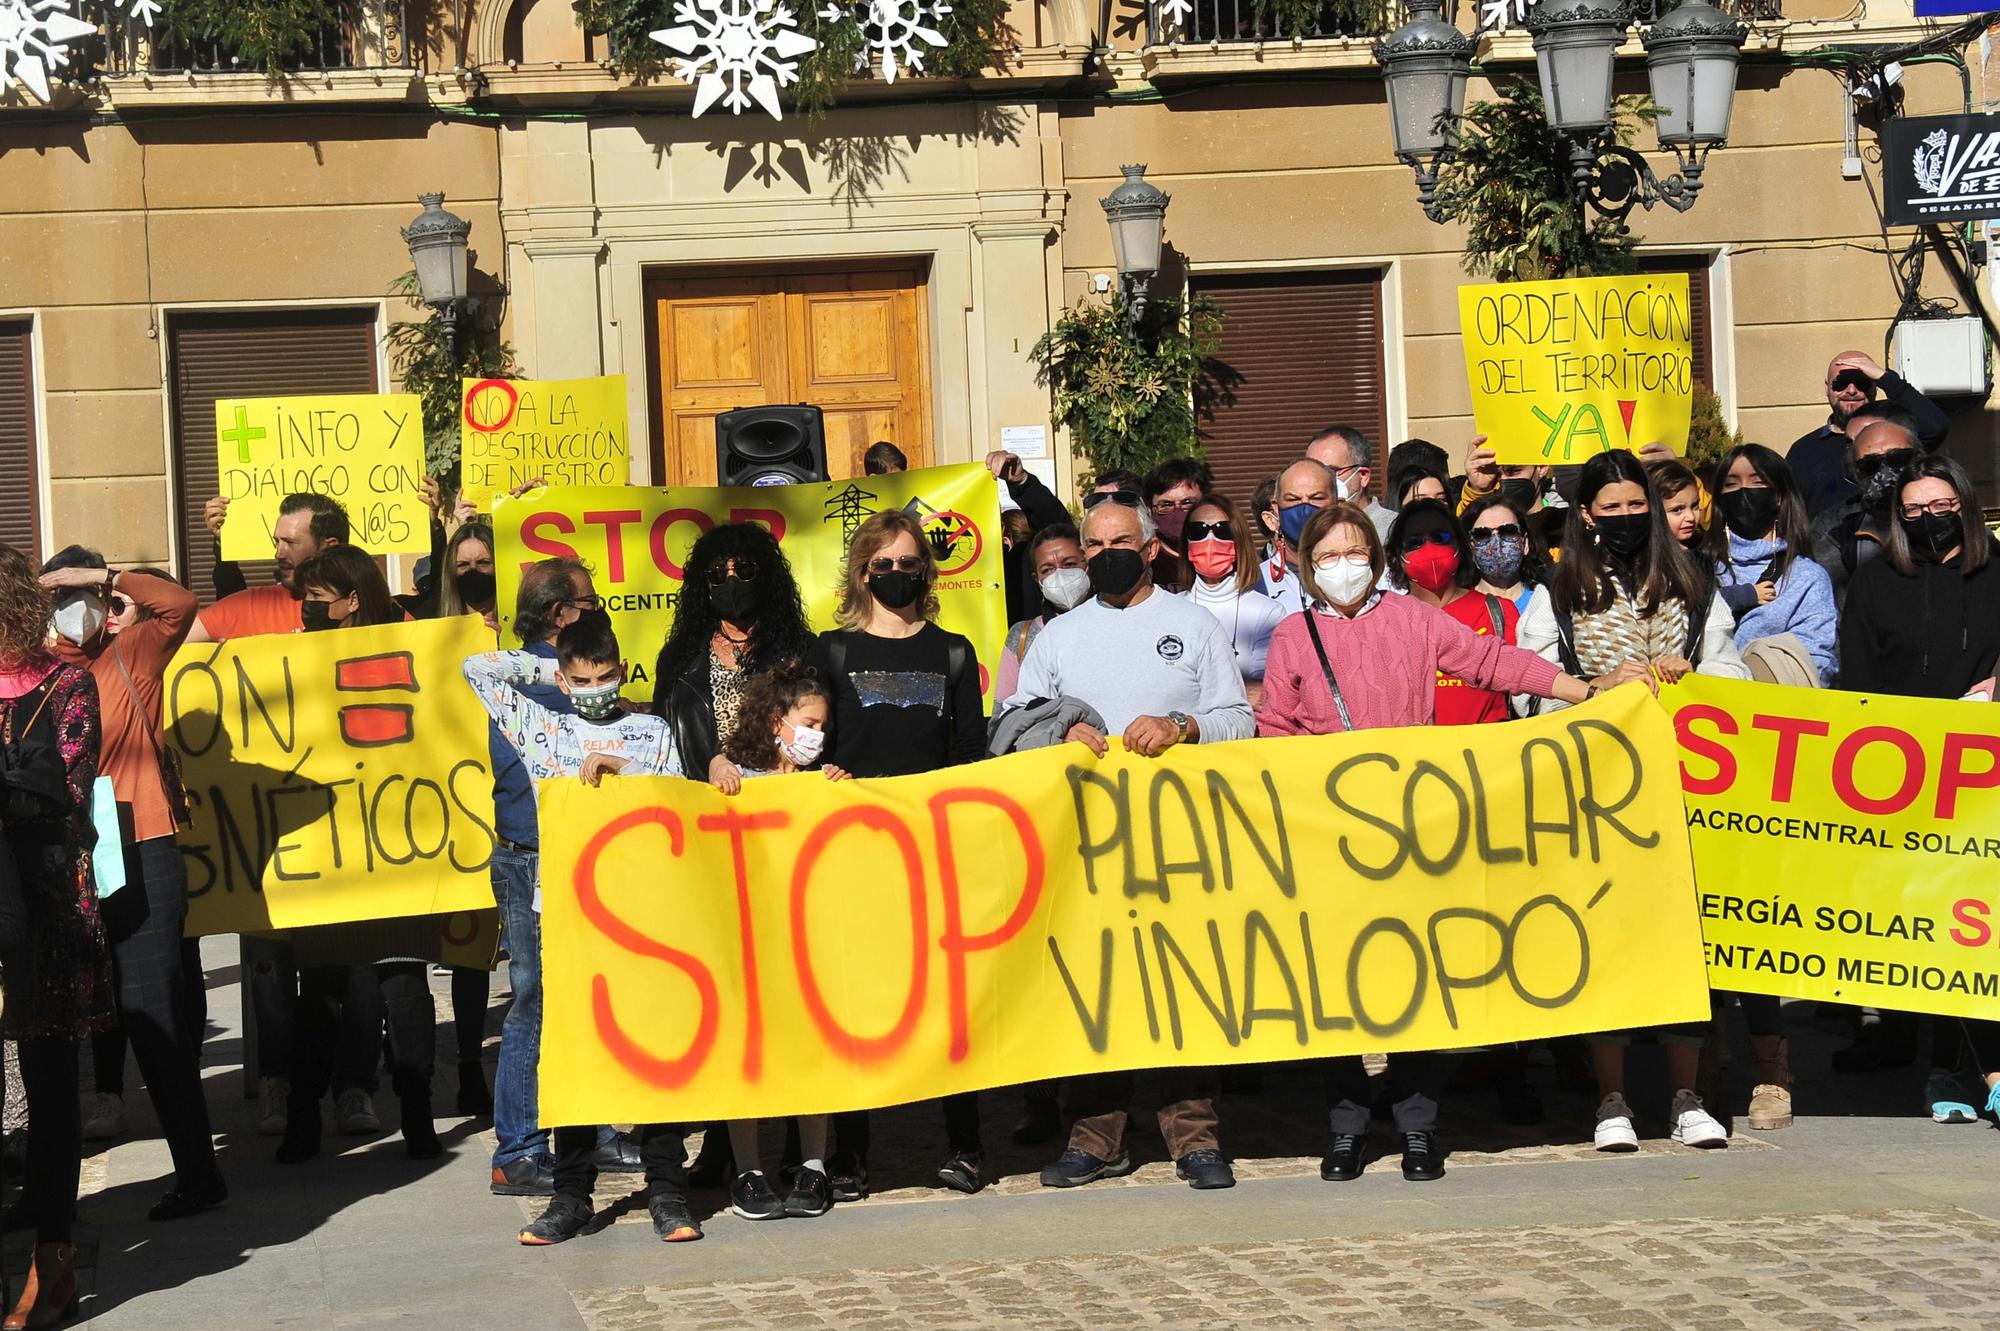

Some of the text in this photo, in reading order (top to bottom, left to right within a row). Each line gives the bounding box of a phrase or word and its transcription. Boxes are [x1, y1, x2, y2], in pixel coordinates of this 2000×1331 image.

[1959, 179, 1980, 194] DE
[1478, 348, 1693, 396] DEL TERRITORIO
[471, 387, 579, 427] NO A LA
[383, 410, 408, 449] Y
[470, 420, 625, 460] DESTRUCCIÓN
[368, 459, 420, 494] CON
[469, 461, 615, 489] DE NUESTRO
[583, 739, 625, 751] RELAX
[1672, 703, 2000, 820] STOP
[1903, 831, 2000, 860] SOLAR
[572, 719, 1660, 1088] STOP PLAN SOLAR
[1814, 906, 1935, 943] SOLAR
[1949, 898, 2000, 948] S
[1048, 881, 1612, 1054] VINALOPÓ
